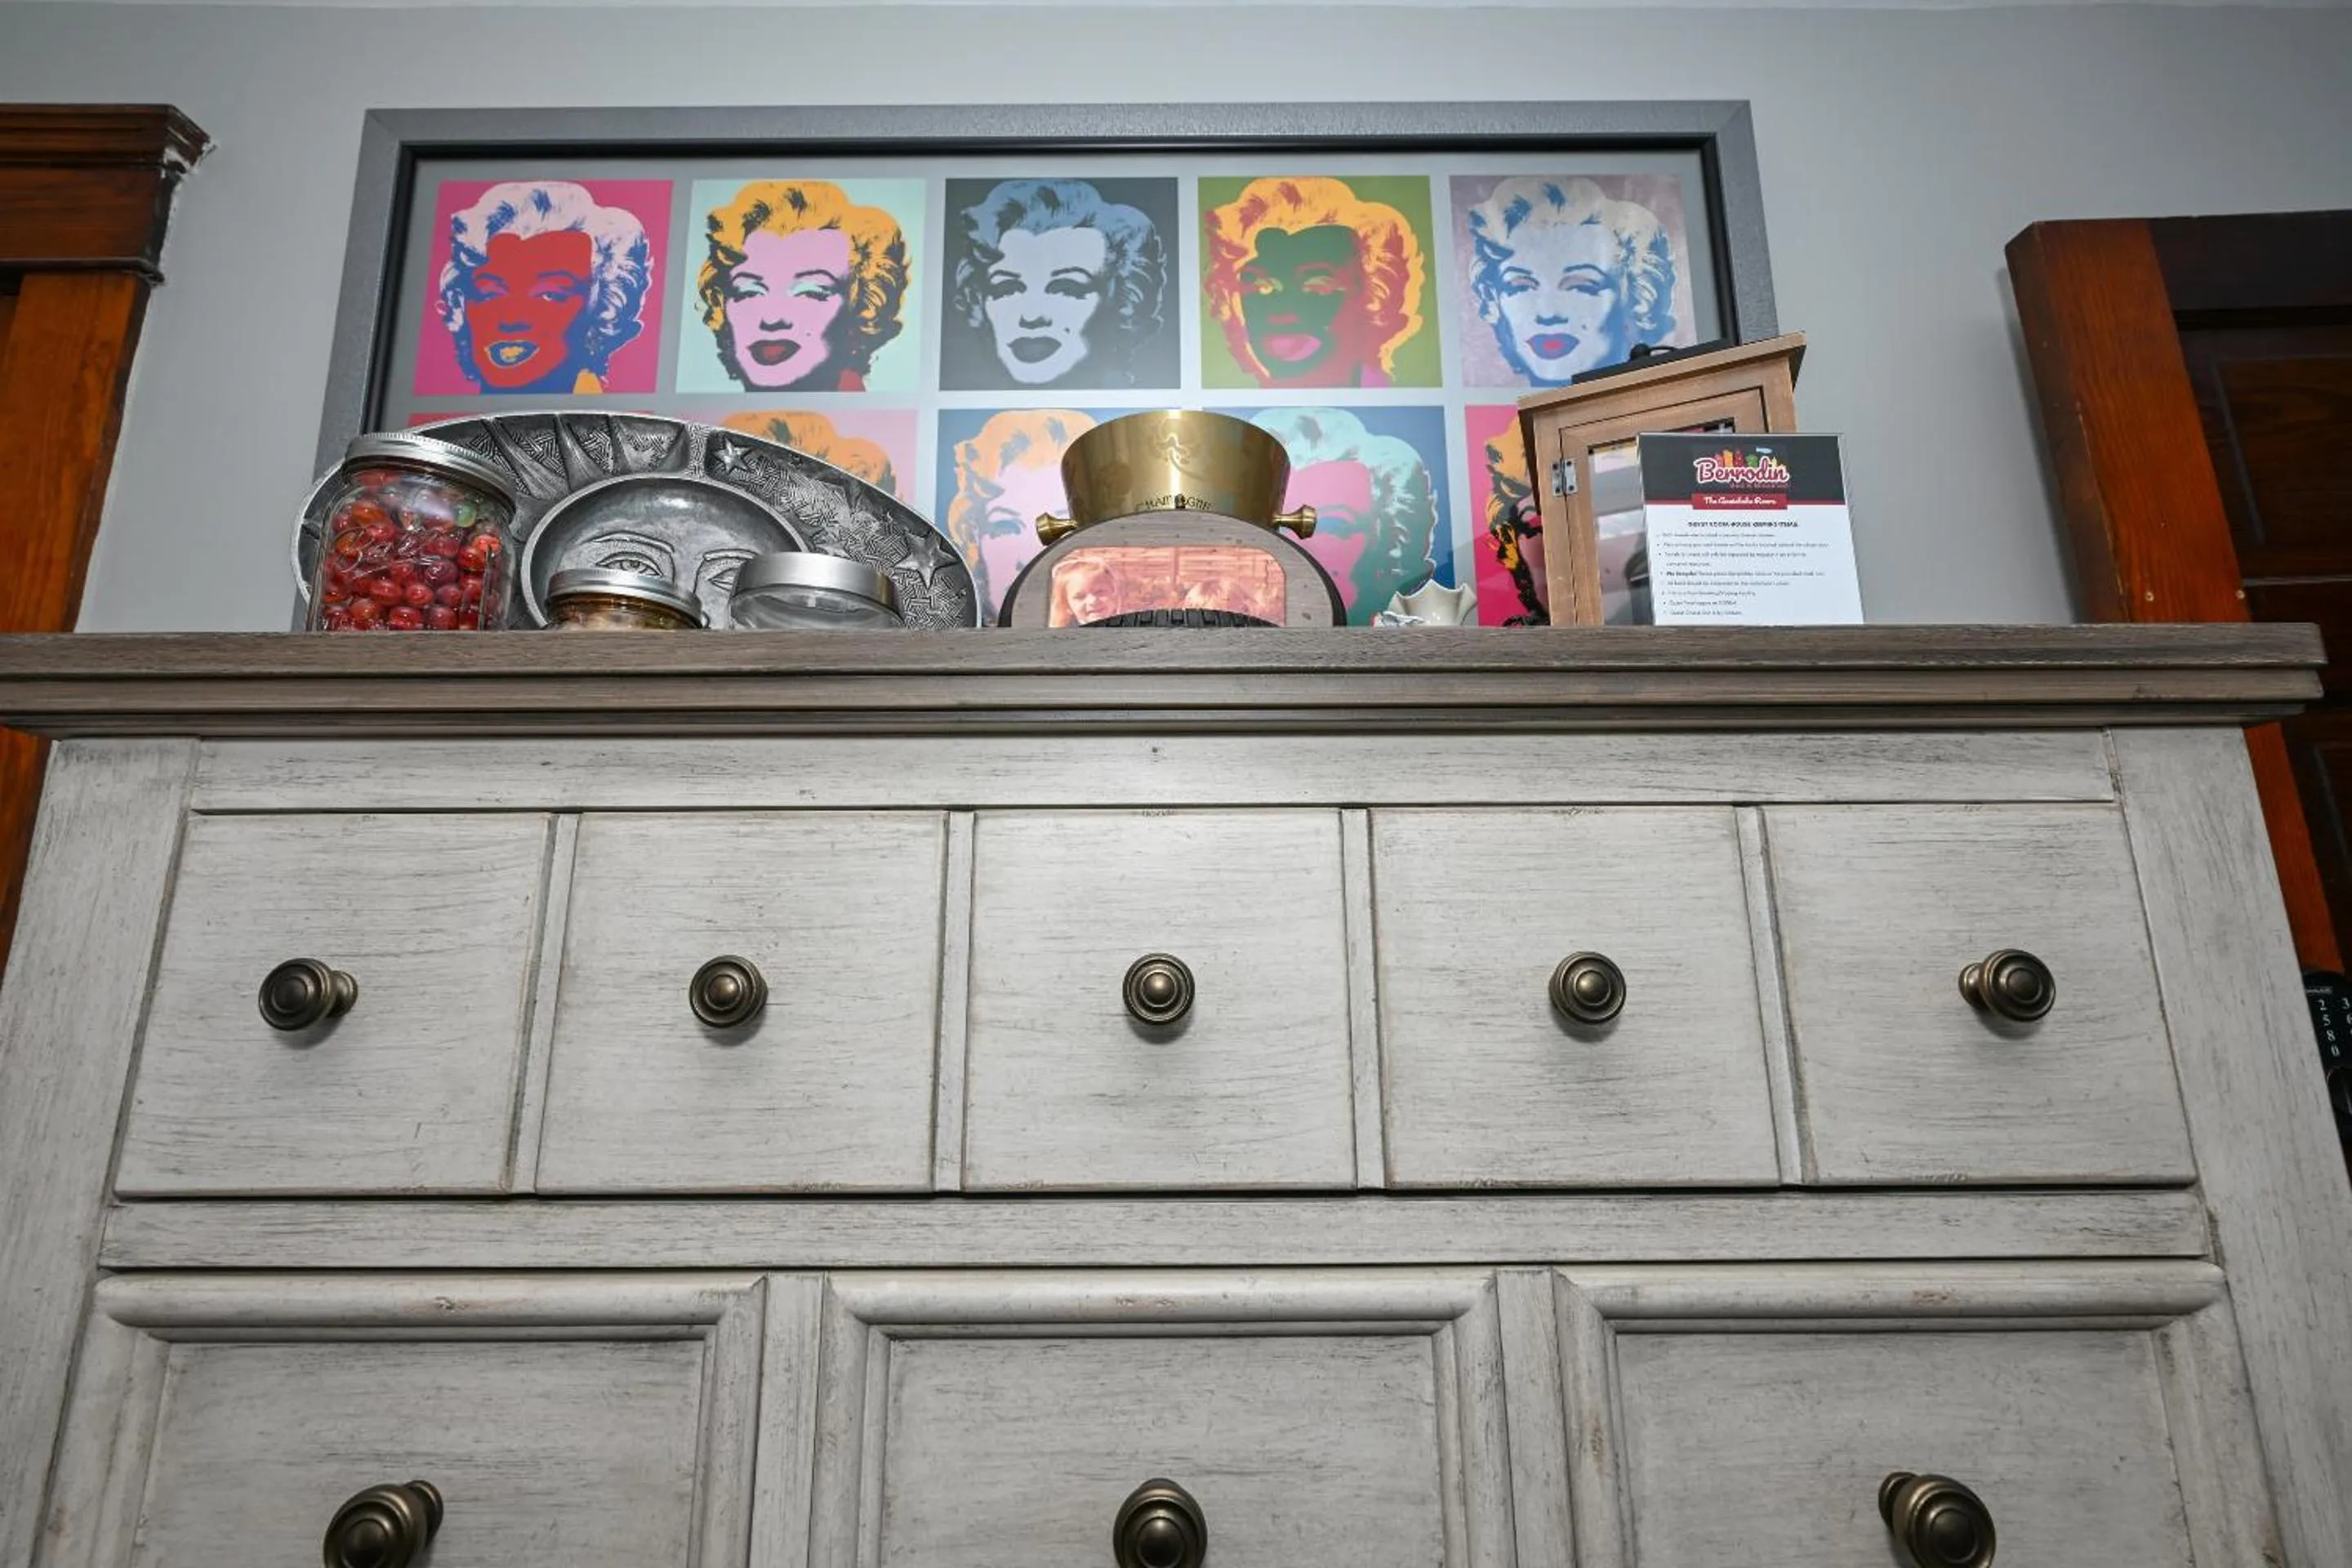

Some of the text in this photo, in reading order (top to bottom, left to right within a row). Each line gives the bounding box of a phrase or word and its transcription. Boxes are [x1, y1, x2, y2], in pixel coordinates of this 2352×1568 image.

[1693, 456, 1790, 483] Berrodin
[2319, 996, 2350, 1011] 2 3
[2323, 1013, 2332, 1027] 5
[2326, 1029, 2336, 1042] 8
